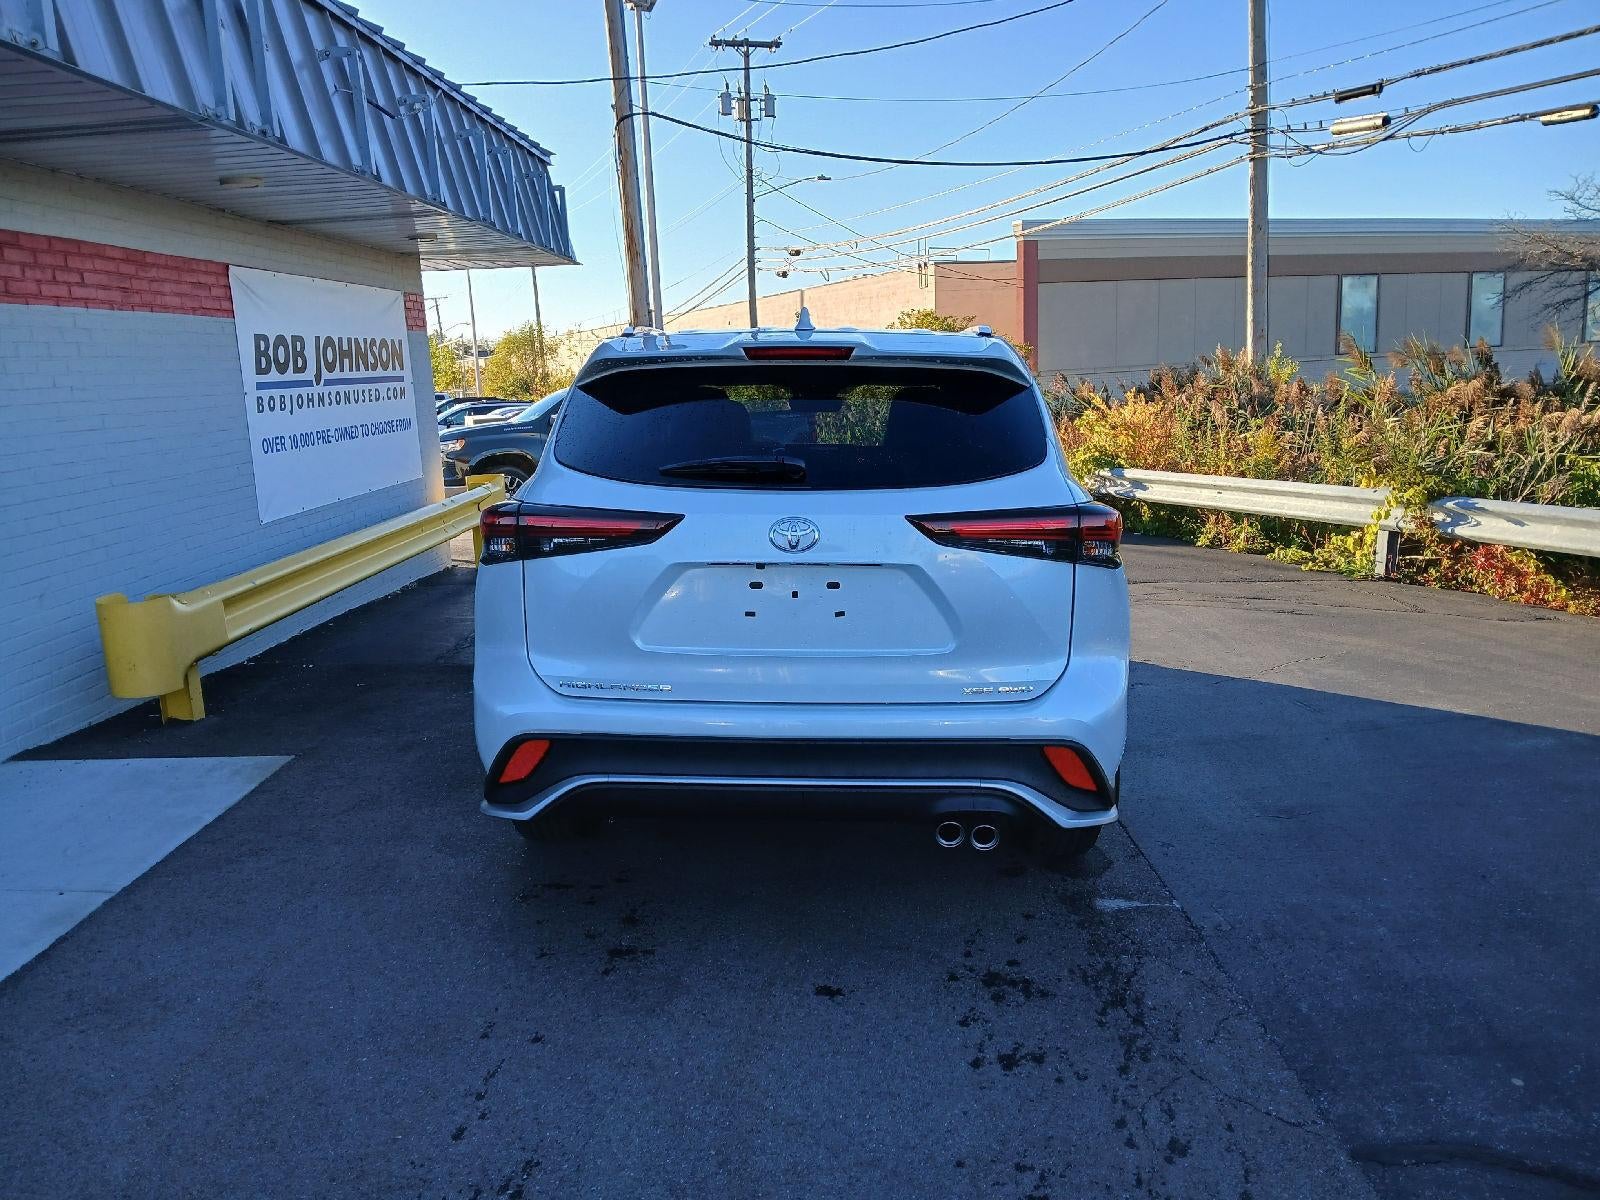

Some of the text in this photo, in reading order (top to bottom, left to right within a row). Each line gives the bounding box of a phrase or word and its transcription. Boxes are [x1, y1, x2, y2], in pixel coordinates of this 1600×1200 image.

[253, 333, 405, 386] BOB JOHNSON
[256, 386, 406, 416] BOBJOHNSONUSED.COM
[261, 417, 412, 455] OVER 10,000 PRE-OWNED TO CHOOSE FROM
[559, 680, 673, 693] HIGHLANDER
